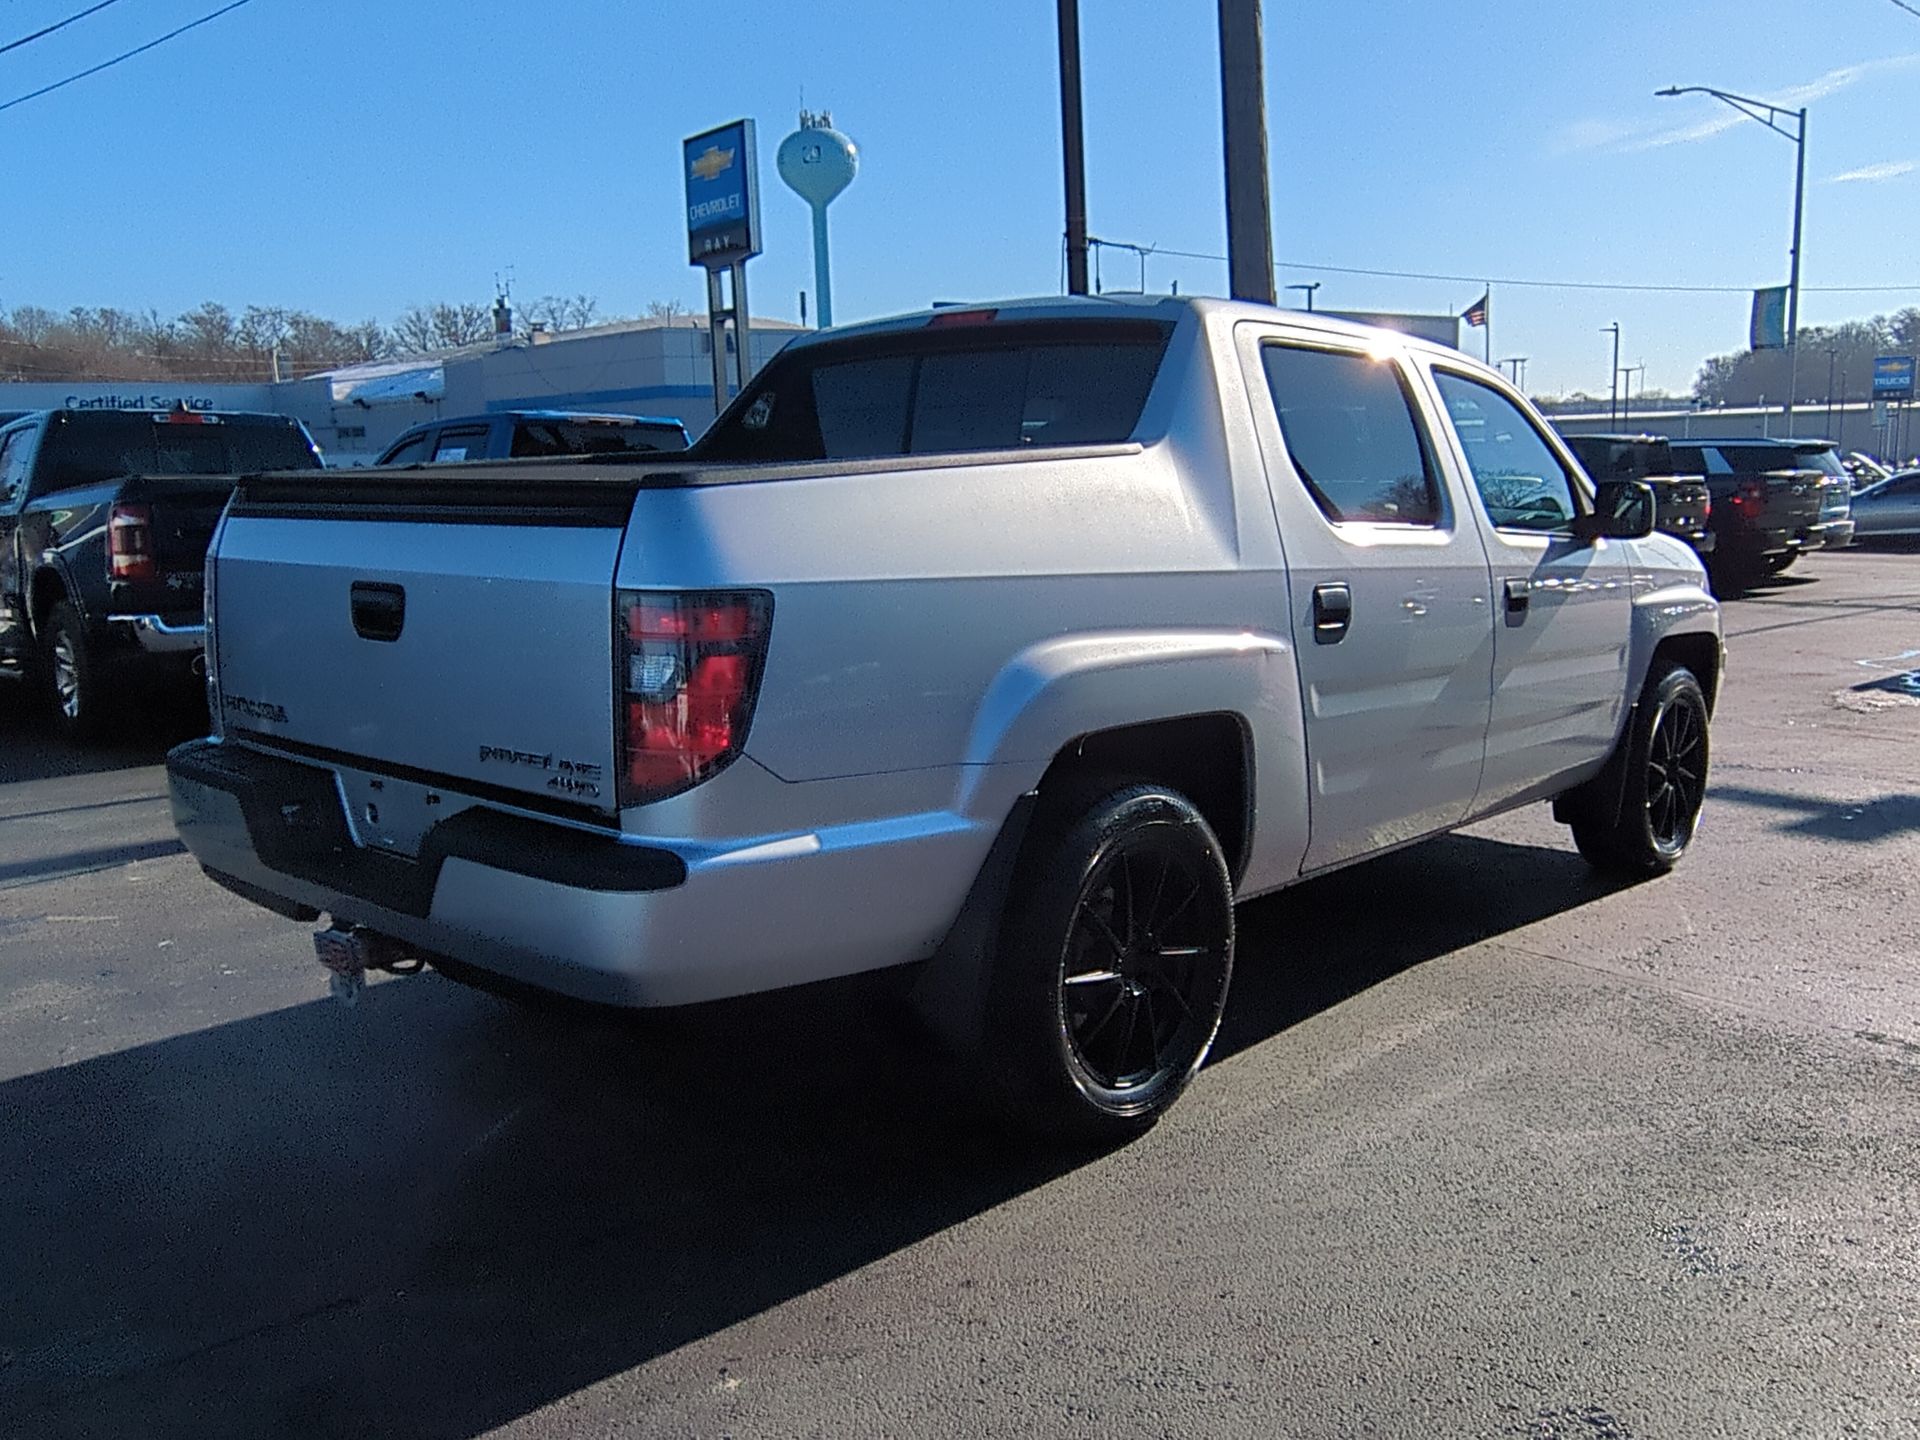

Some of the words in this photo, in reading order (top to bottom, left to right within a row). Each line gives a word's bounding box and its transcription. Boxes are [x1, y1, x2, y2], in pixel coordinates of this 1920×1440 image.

[689, 193, 740, 221] CHEVROLET
[704, 235, 730, 252] RAY
[65, 396, 144, 410] Certified
[150, 395, 214, 411] Sevice
